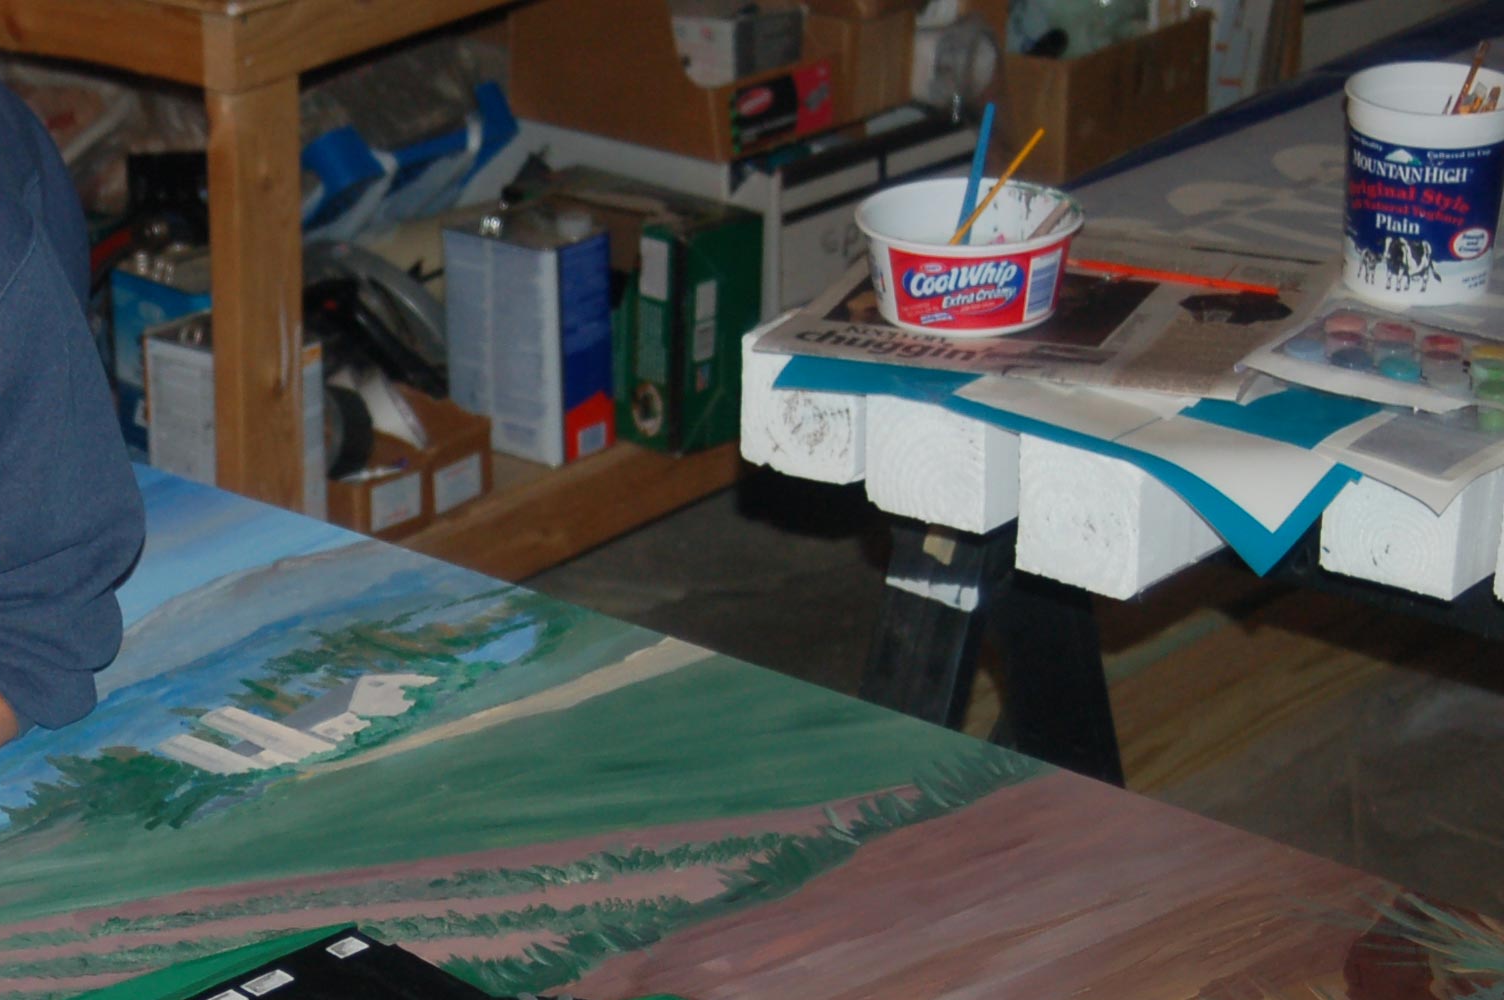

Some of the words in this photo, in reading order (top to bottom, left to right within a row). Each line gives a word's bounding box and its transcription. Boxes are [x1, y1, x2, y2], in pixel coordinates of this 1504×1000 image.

[1353, 149, 1423, 185] MOUNTAIN
[1424, 165, 1468, 184] HIGH
[1422, 187, 1471, 214] Style
[1375, 212, 1421, 235] Plain
[941, 292, 975, 309] Extra
